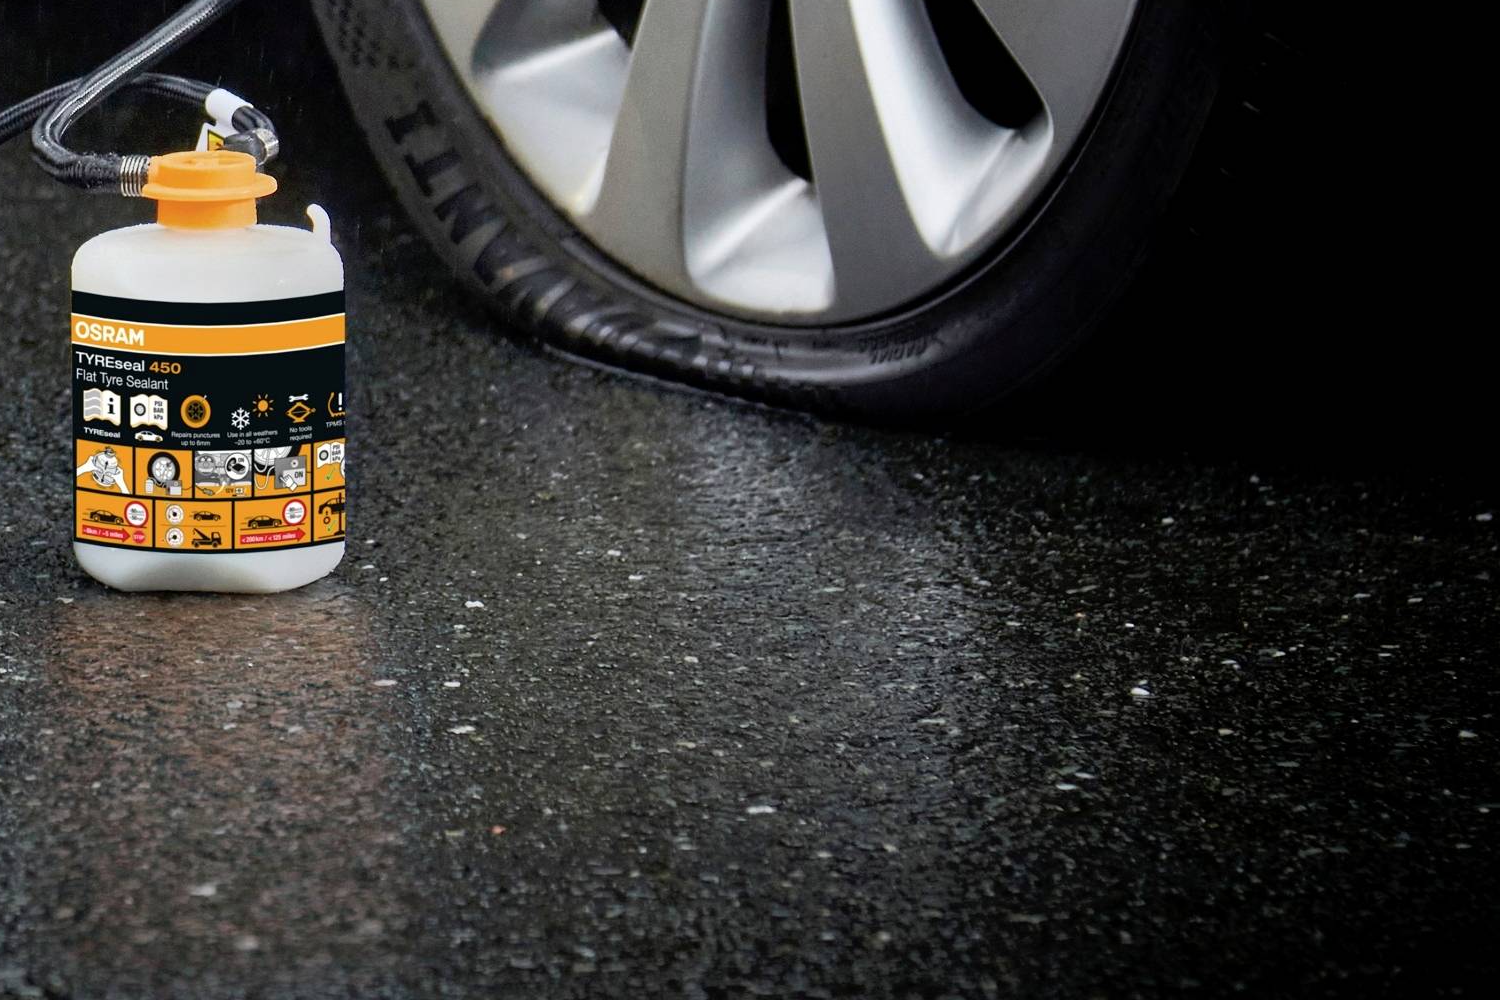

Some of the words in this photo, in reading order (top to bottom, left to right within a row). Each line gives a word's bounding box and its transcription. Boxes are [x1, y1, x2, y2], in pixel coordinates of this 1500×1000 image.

[75, 321, 145, 347] OSRAM
[75, 351, 146, 372] TYREseal
[148, 360, 182, 375] 450
[76, 368, 97, 383] Flat
[99, 371, 124, 388] Tyre
[125, 374, 169, 391] Sealant
[326, 420, 342, 428] TPMS
[83, 426, 121, 439] TYREseal
[298, 425, 312, 433] tools
[171, 431, 193, 439] Repairs
[193, 431, 221, 439] punctures
[226, 431, 239, 439] Use
[253, 429, 278, 437] weathers
[289, 433, 313, 441] required
[294, 471, 304, 479] ON
